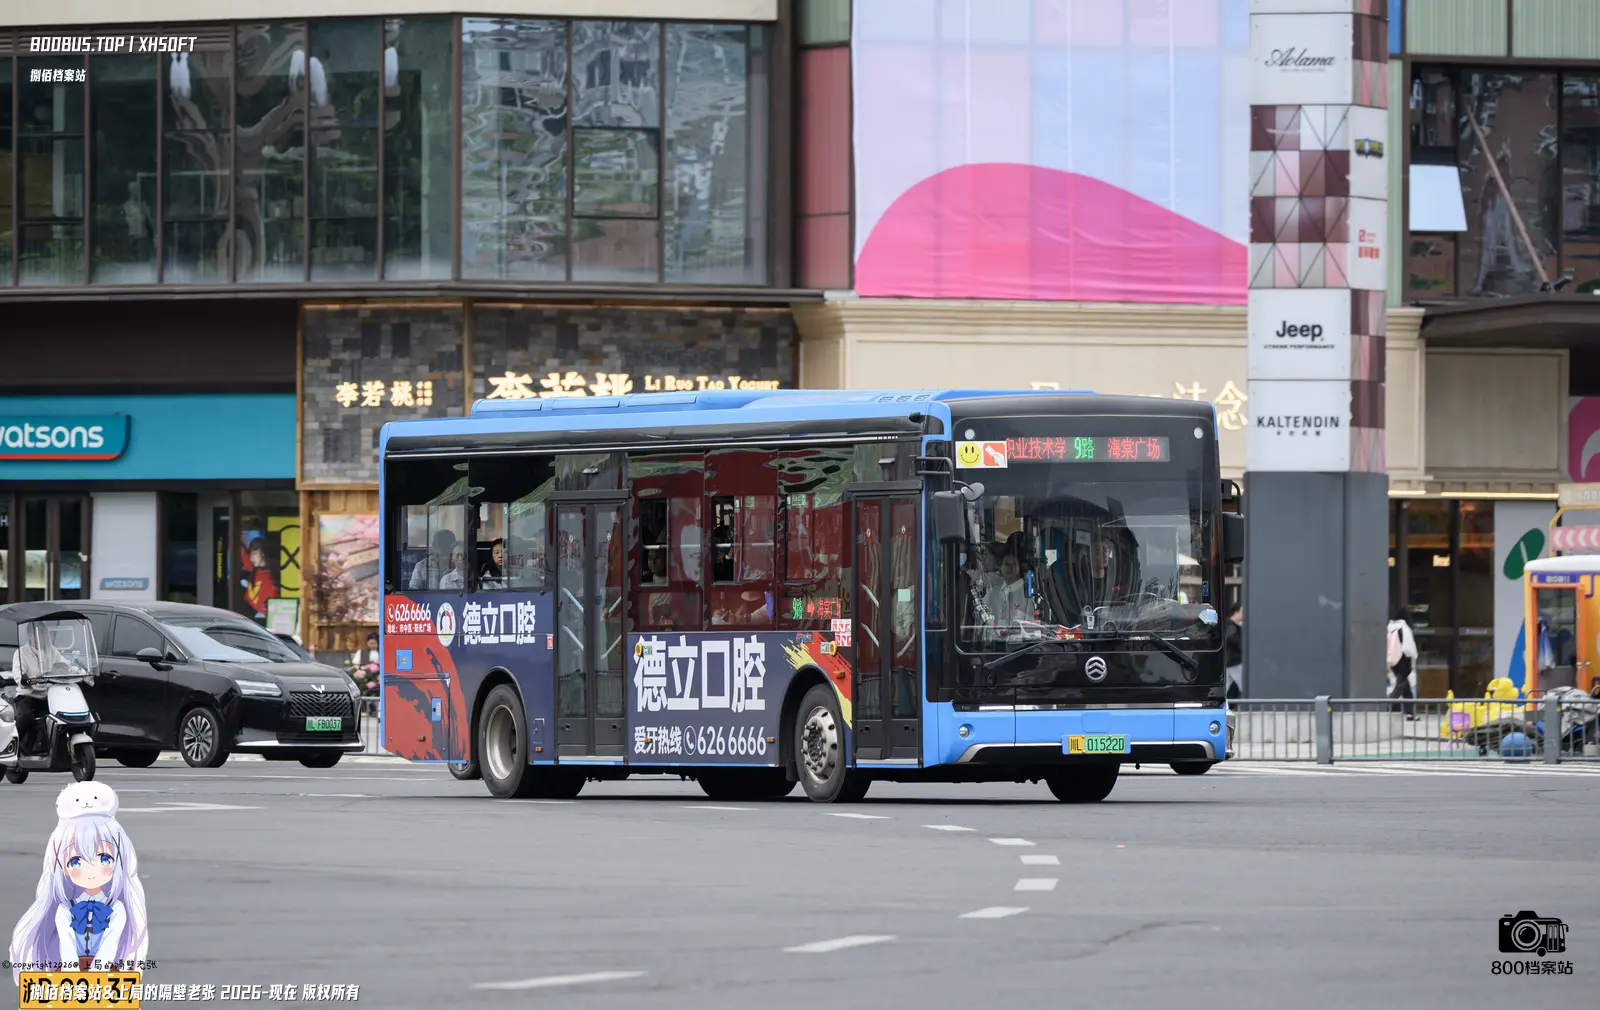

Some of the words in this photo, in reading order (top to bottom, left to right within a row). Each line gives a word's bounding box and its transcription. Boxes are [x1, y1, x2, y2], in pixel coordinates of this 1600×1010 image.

[1276, 320, 1323, 342] Jeep
[1256, 415, 1340, 429] KALTENDIN
[1073, 436, 1095, 460] 9路
[1107, 436, 1161, 460] 海棠广场
[462, 600, 536, 646] 德立口腔
[633, 635, 766, 713] 德立口腔
[634, 726, 683, 755] 爱牙热线
